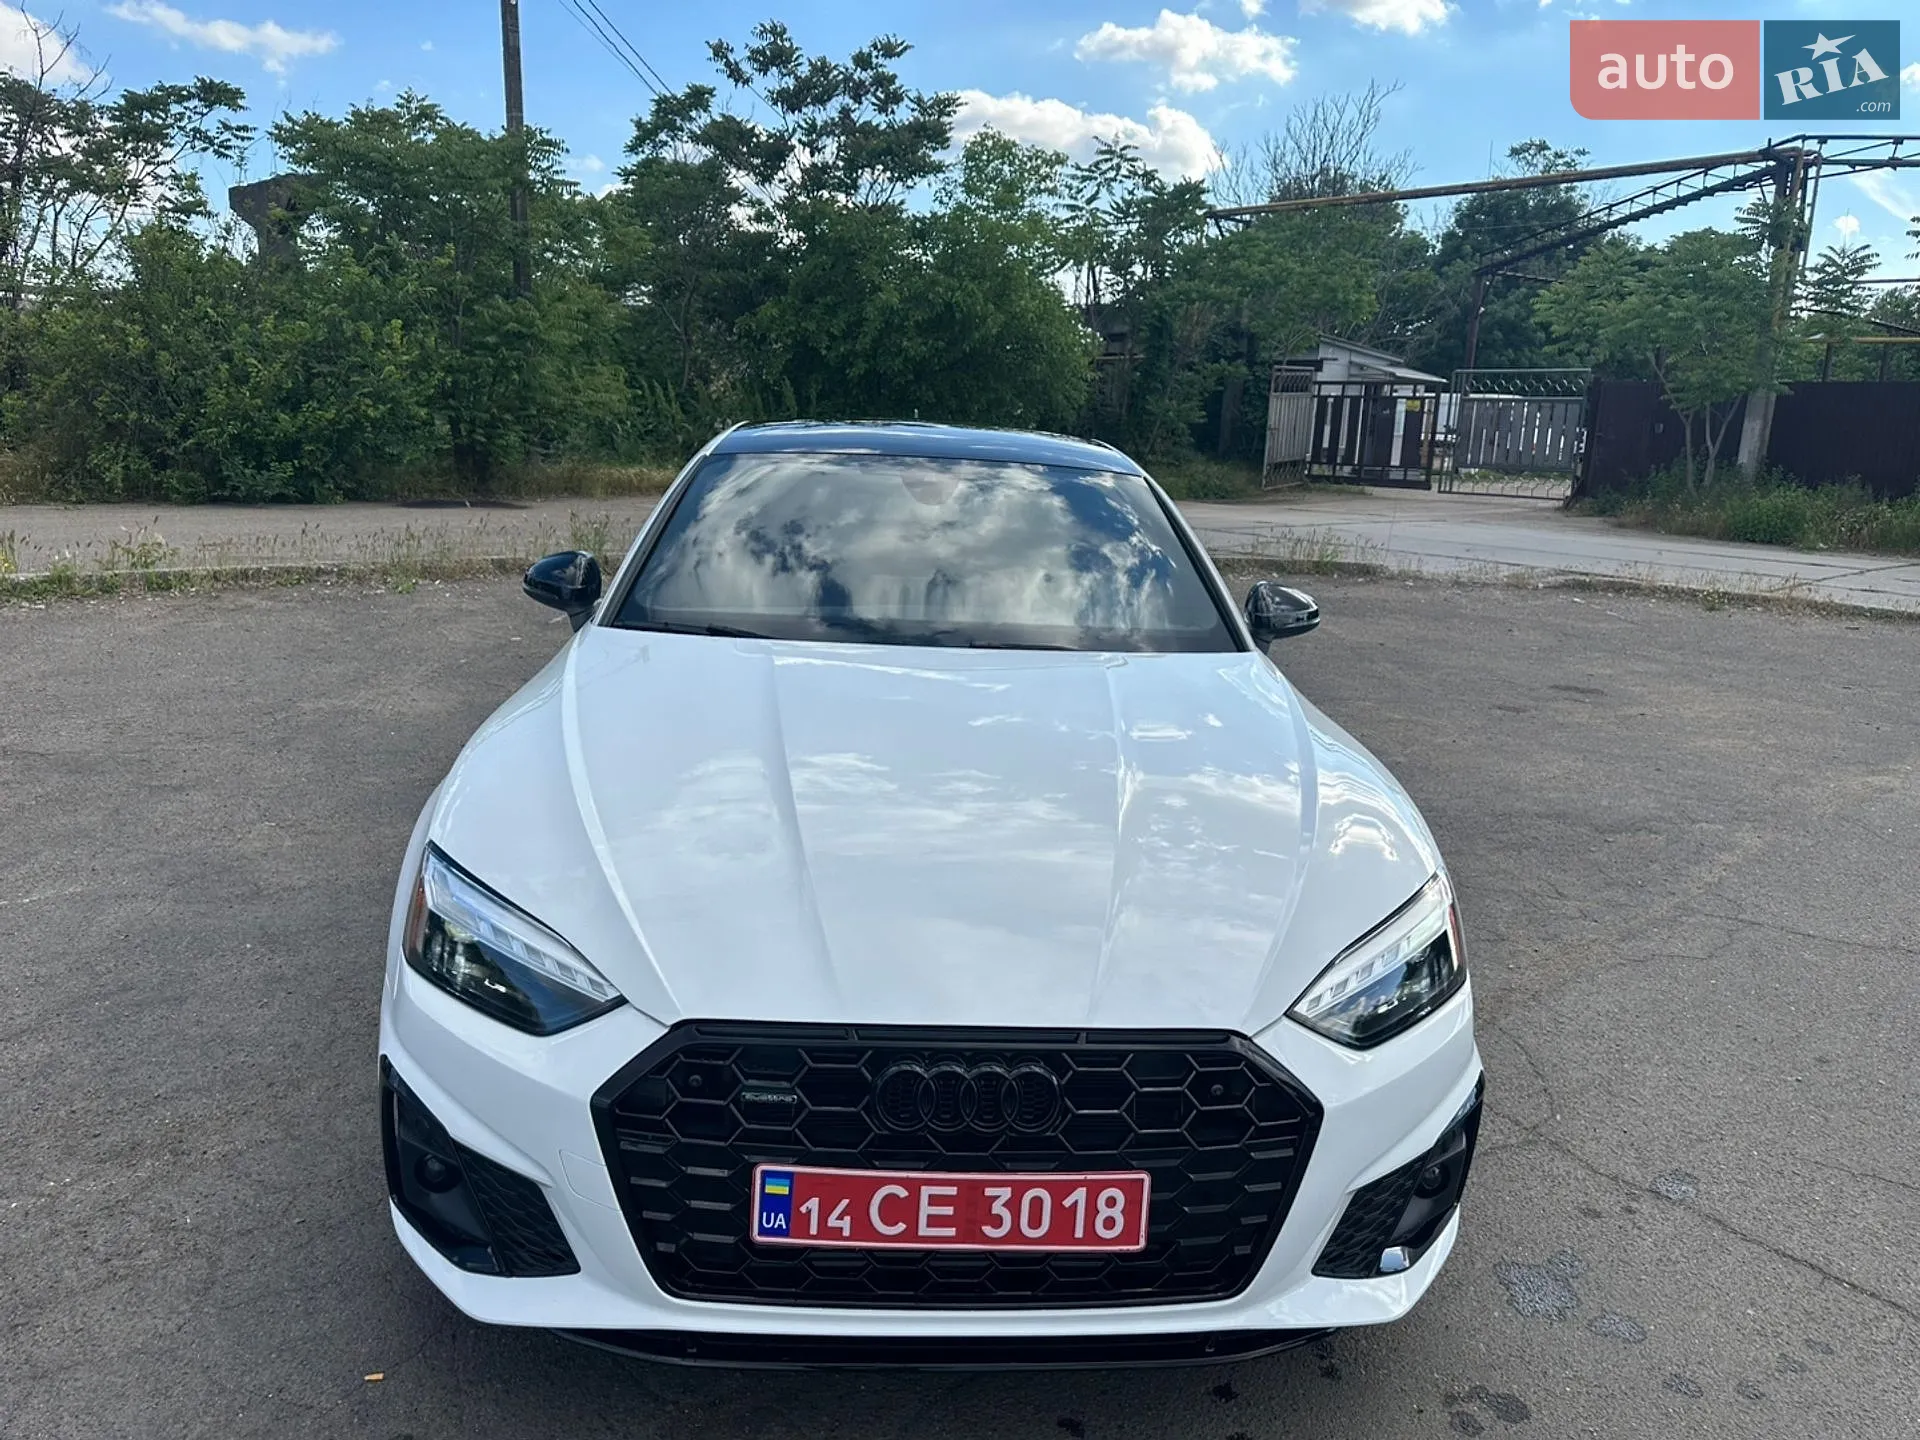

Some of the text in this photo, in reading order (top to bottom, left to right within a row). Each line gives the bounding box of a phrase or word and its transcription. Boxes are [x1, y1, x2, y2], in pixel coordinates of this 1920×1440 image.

[762, 1211, 787, 1230] UA
[799, 1184, 1125, 1240] 14 CE 3018
